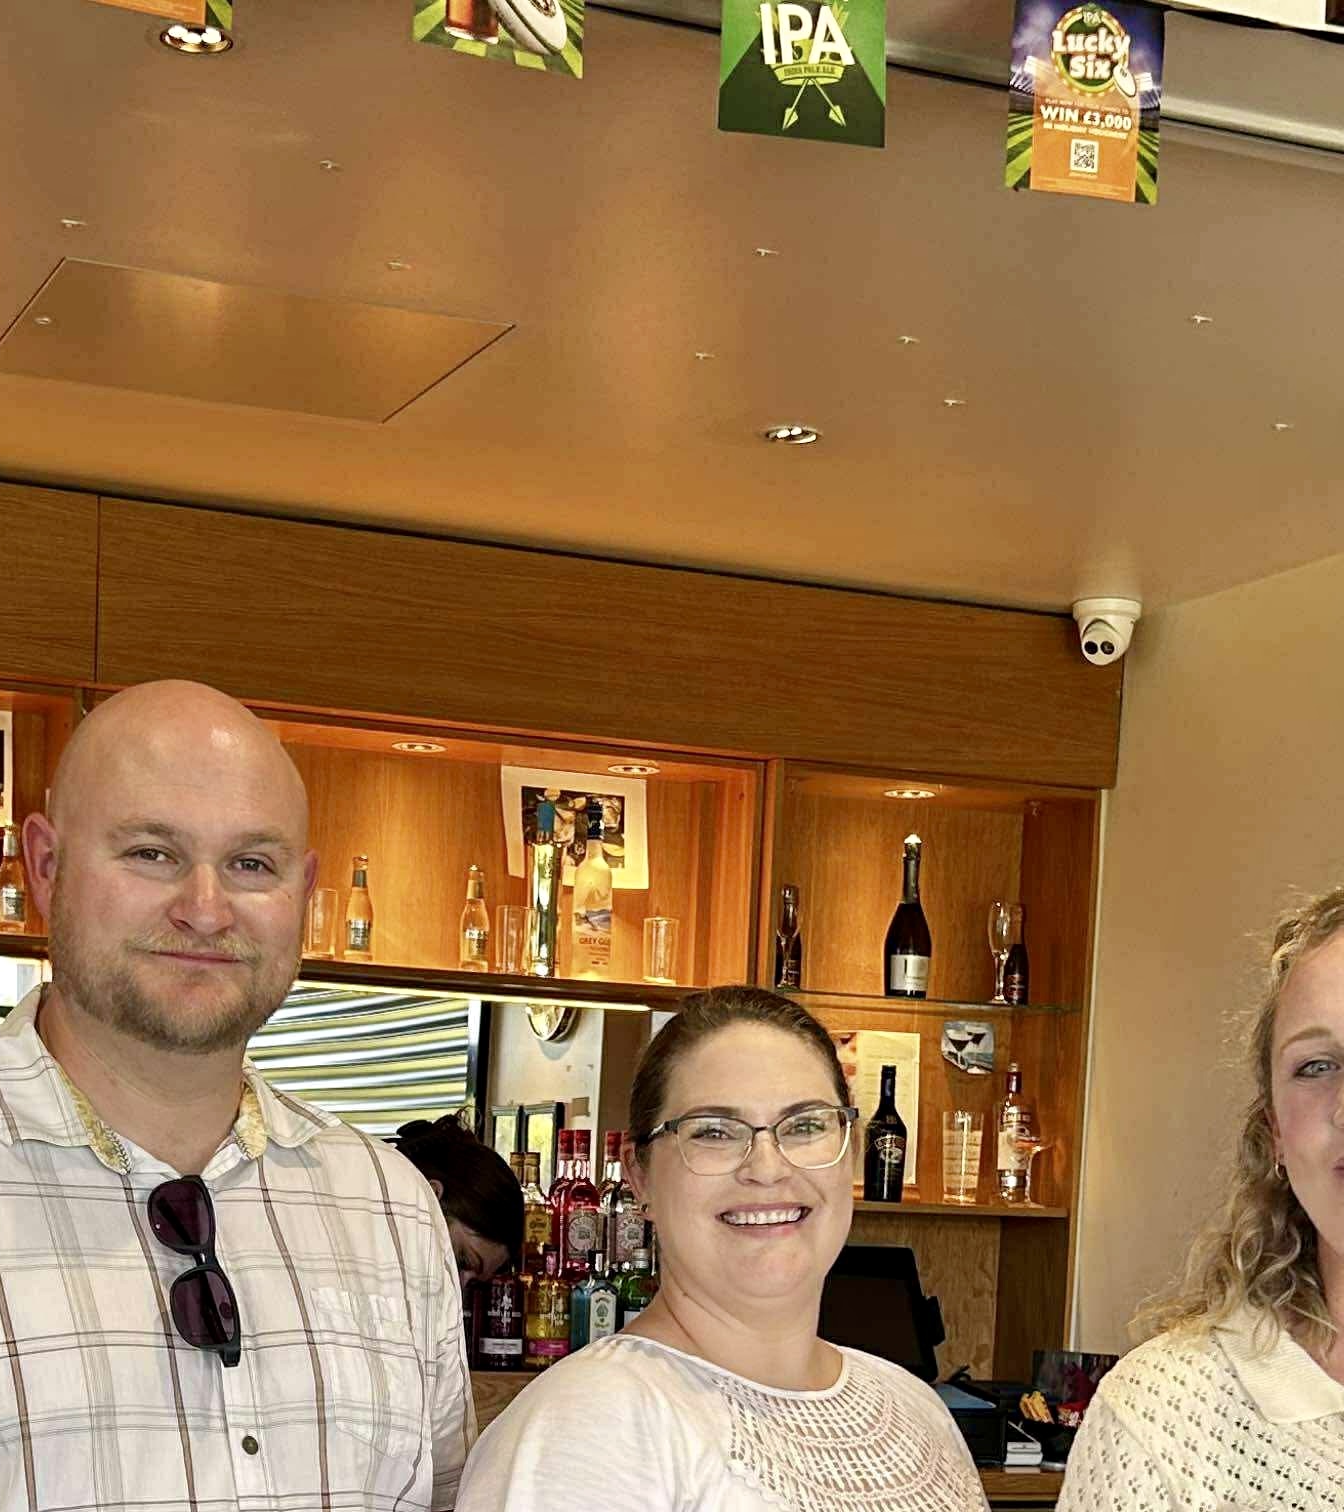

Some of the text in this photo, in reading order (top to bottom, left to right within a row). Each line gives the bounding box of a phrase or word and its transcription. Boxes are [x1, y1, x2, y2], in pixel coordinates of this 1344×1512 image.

[760, 3, 855, 65] IPA
[1052, 27, 1131, 59] Lucky
[1069, 54, 1111, 79] Six
[1040, 105, 1080, 122] WIN
[1083, 112, 1132, 131] £3,000
